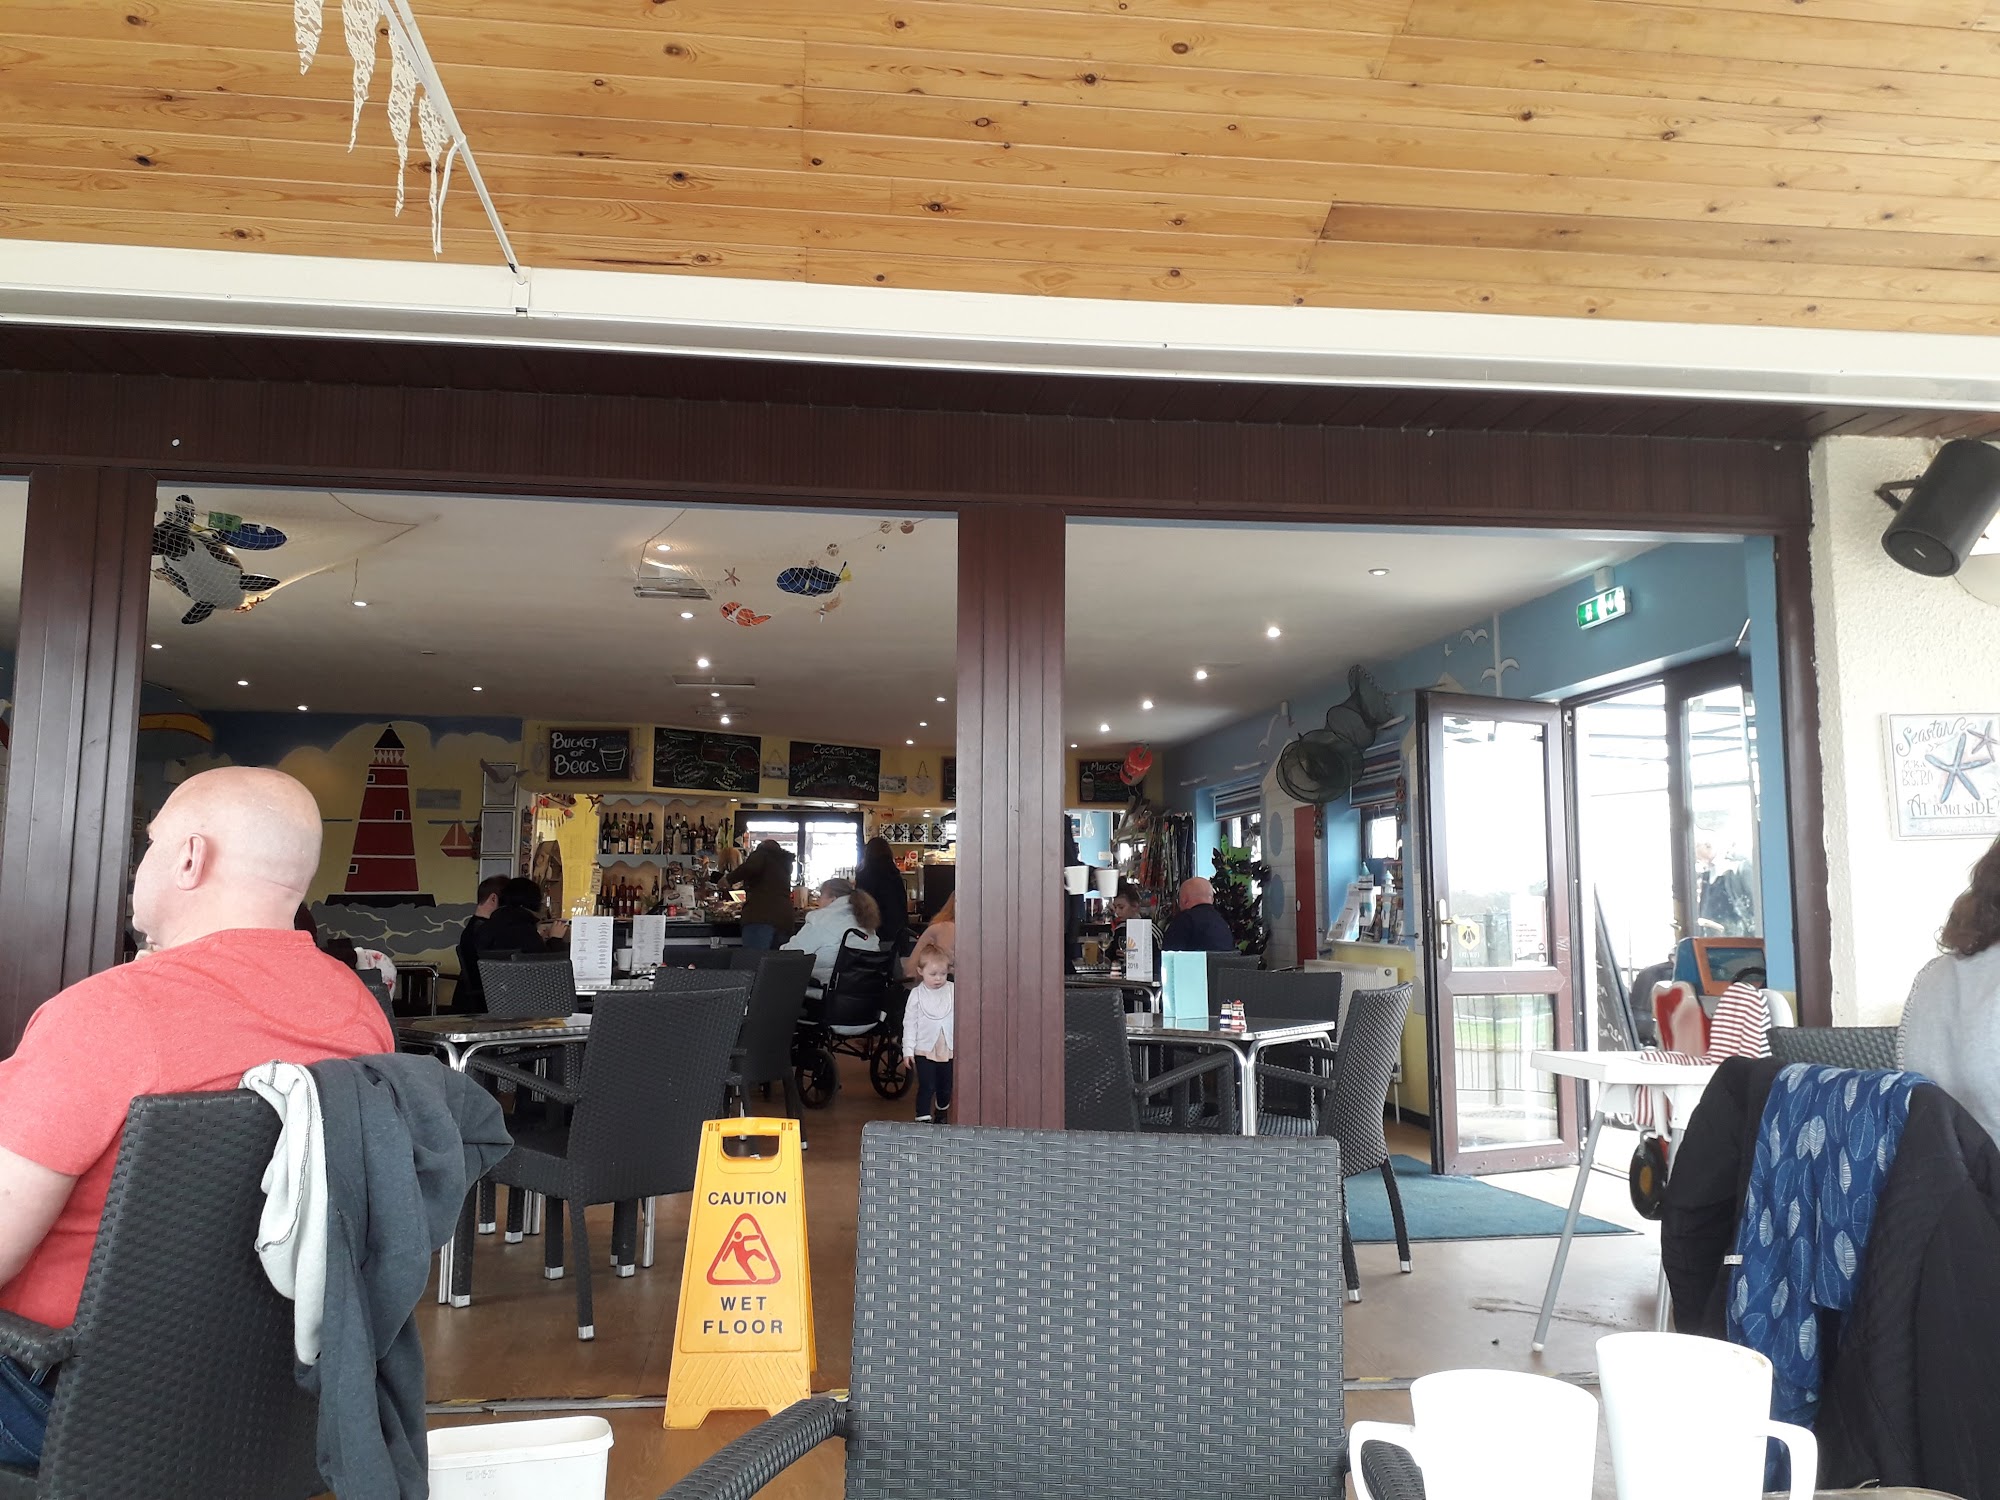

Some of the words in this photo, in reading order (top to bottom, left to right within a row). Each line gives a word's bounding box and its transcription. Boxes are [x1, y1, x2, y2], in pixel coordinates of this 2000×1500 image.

[551, 732, 599, 749] BUCKET
[708, 1191, 787, 1205] CAUTION
[720, 1296, 767, 1311] WET
[703, 1319, 783, 1334] FLOOR
